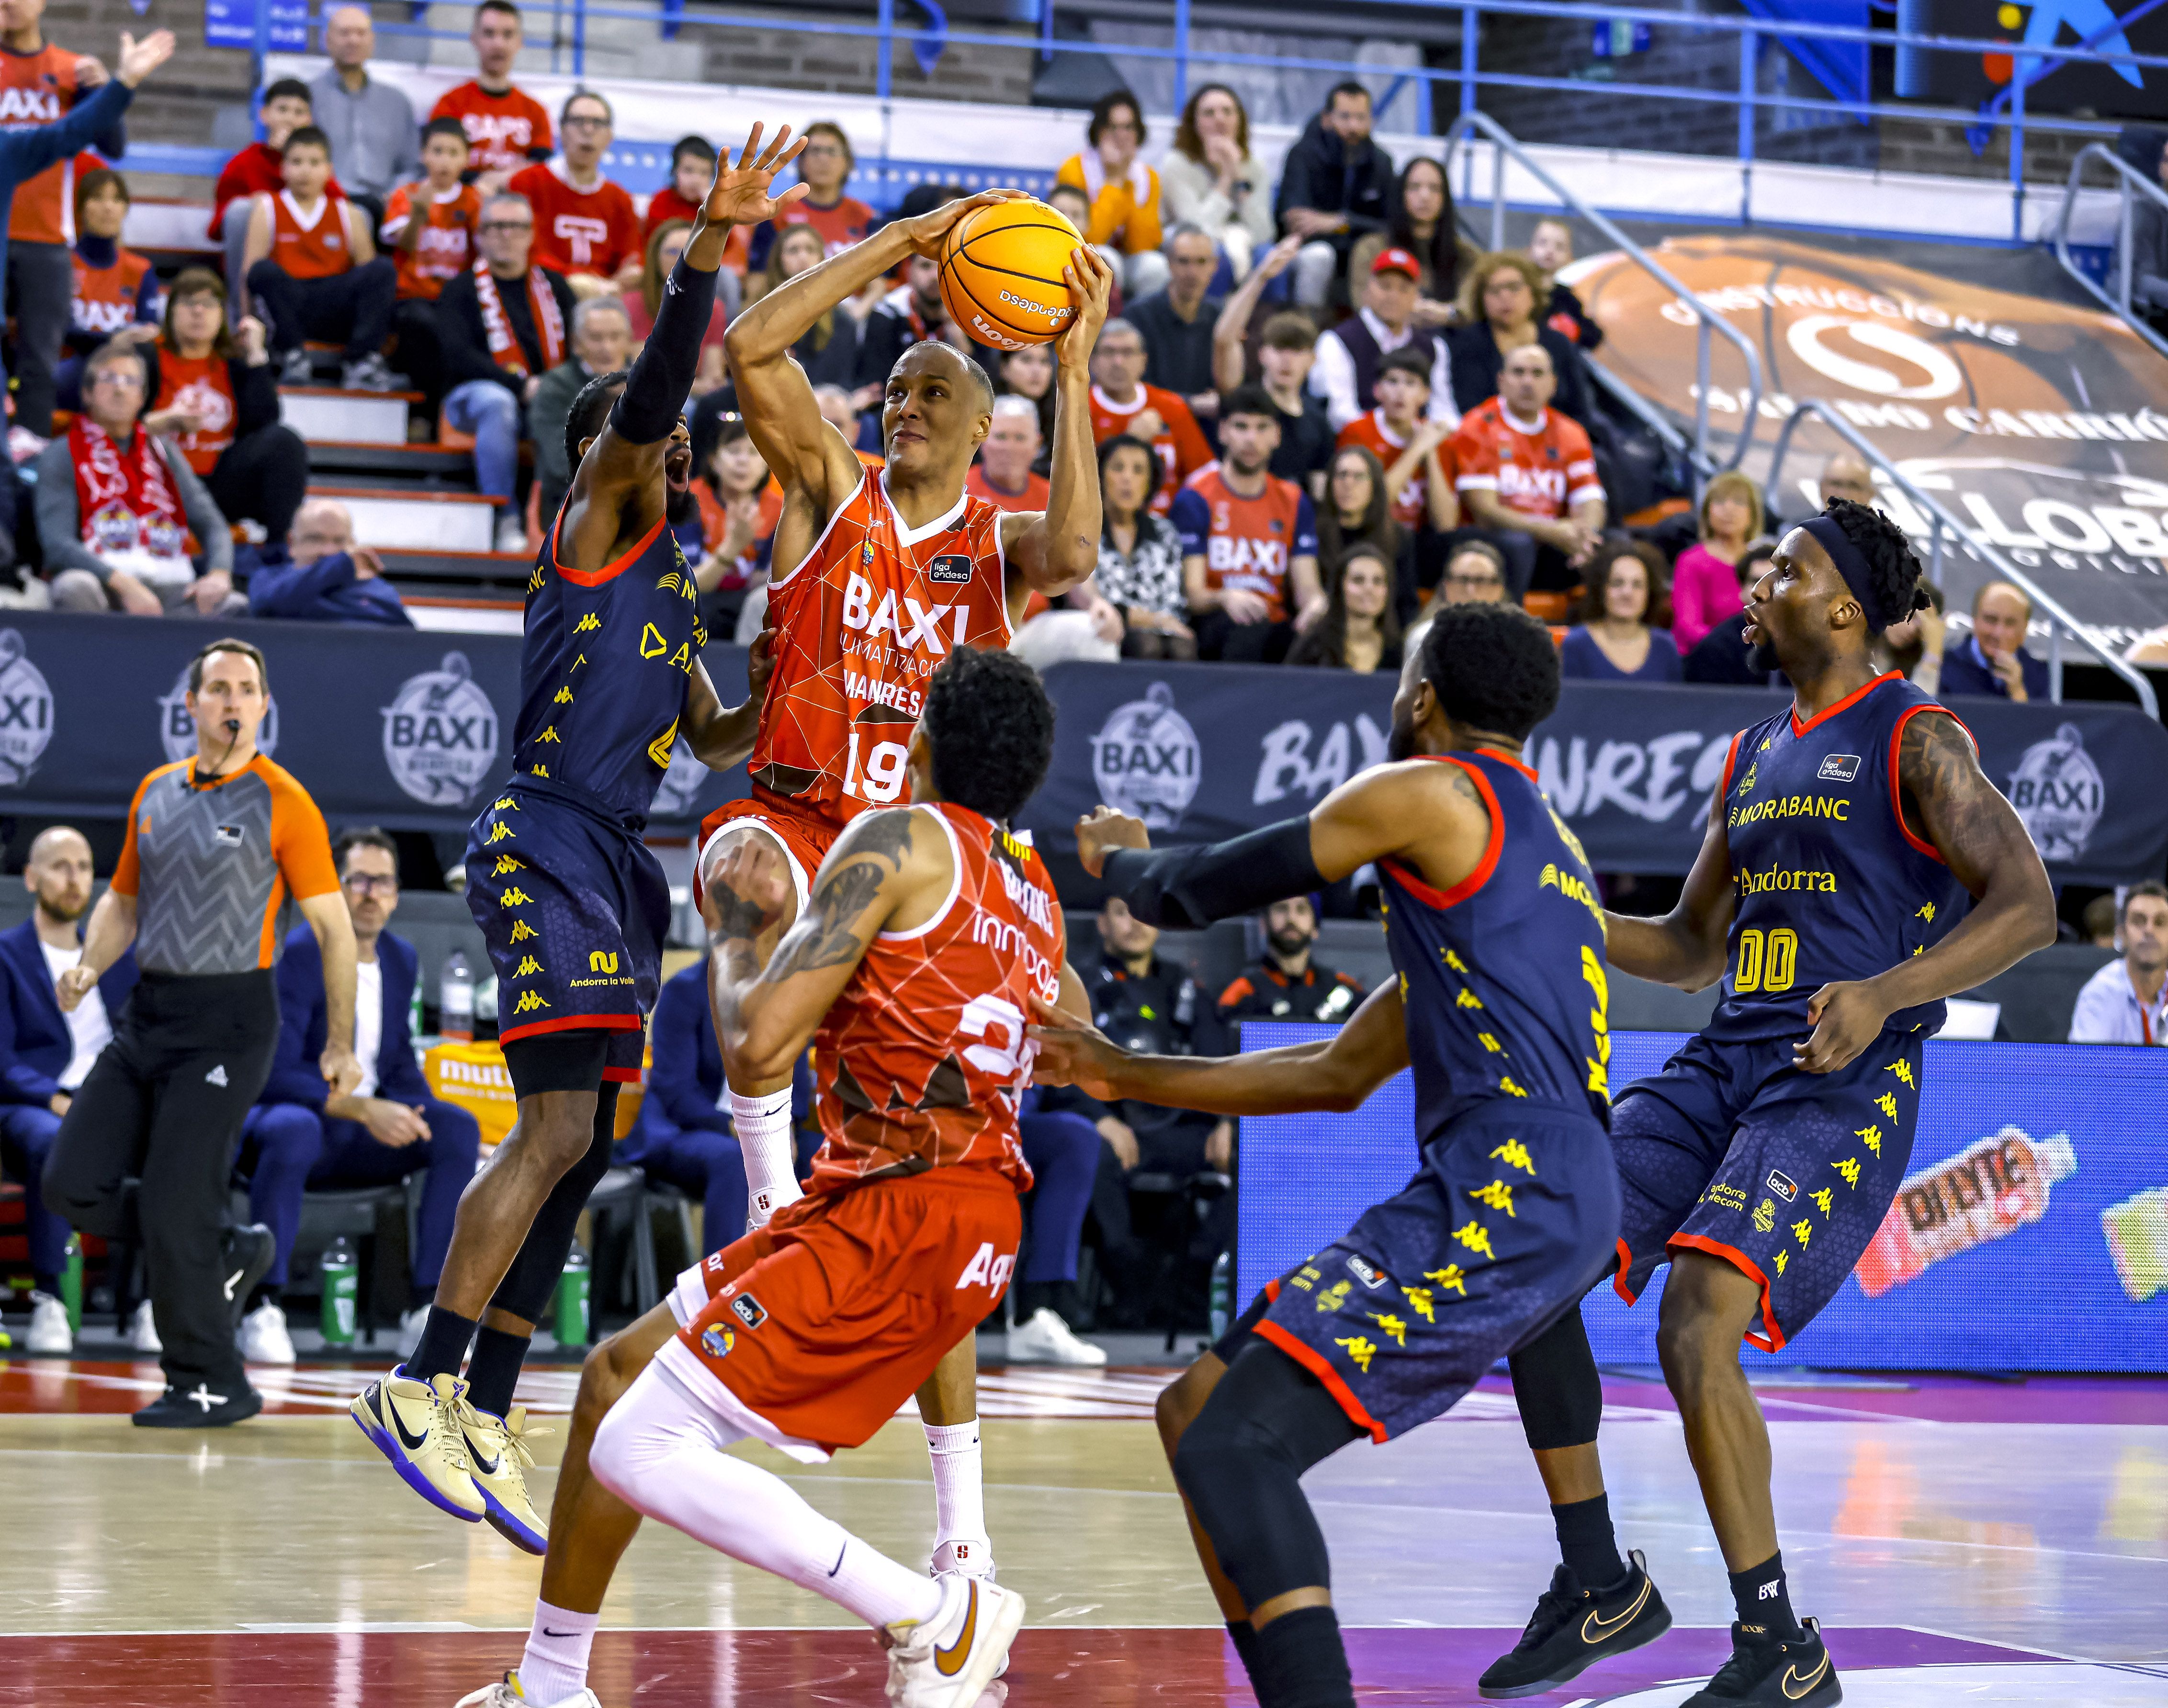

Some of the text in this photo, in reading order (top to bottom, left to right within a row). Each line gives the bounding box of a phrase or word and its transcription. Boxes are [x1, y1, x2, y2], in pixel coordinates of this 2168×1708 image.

[935, 563, 950, 572] liga
[1207, 535, 1288, 576] BAXI
[934, 571, 968, 580] endesa
[842, 570, 970, 654] BAXI
[843, 669, 926, 717] MANRES
[392, 715, 491, 751] BAXI
[842, 733, 909, 802] 19
[1102, 743, 1193, 777] BAXI
[1822, 768, 1852, 778] endesa
[1824, 760, 1839, 769] liga
[1737, 795, 1850, 828] MORABANC
[2014, 779, 2099, 812] BAXI
[1741, 861, 1838, 897] Andorra
[1734, 928, 1798, 993] 00
[570, 978, 609, 988] Andorra
[610, 977, 619, 986] la
[1771, 1178, 1789, 1196] acb
[734, 1300, 754, 1321] acb
